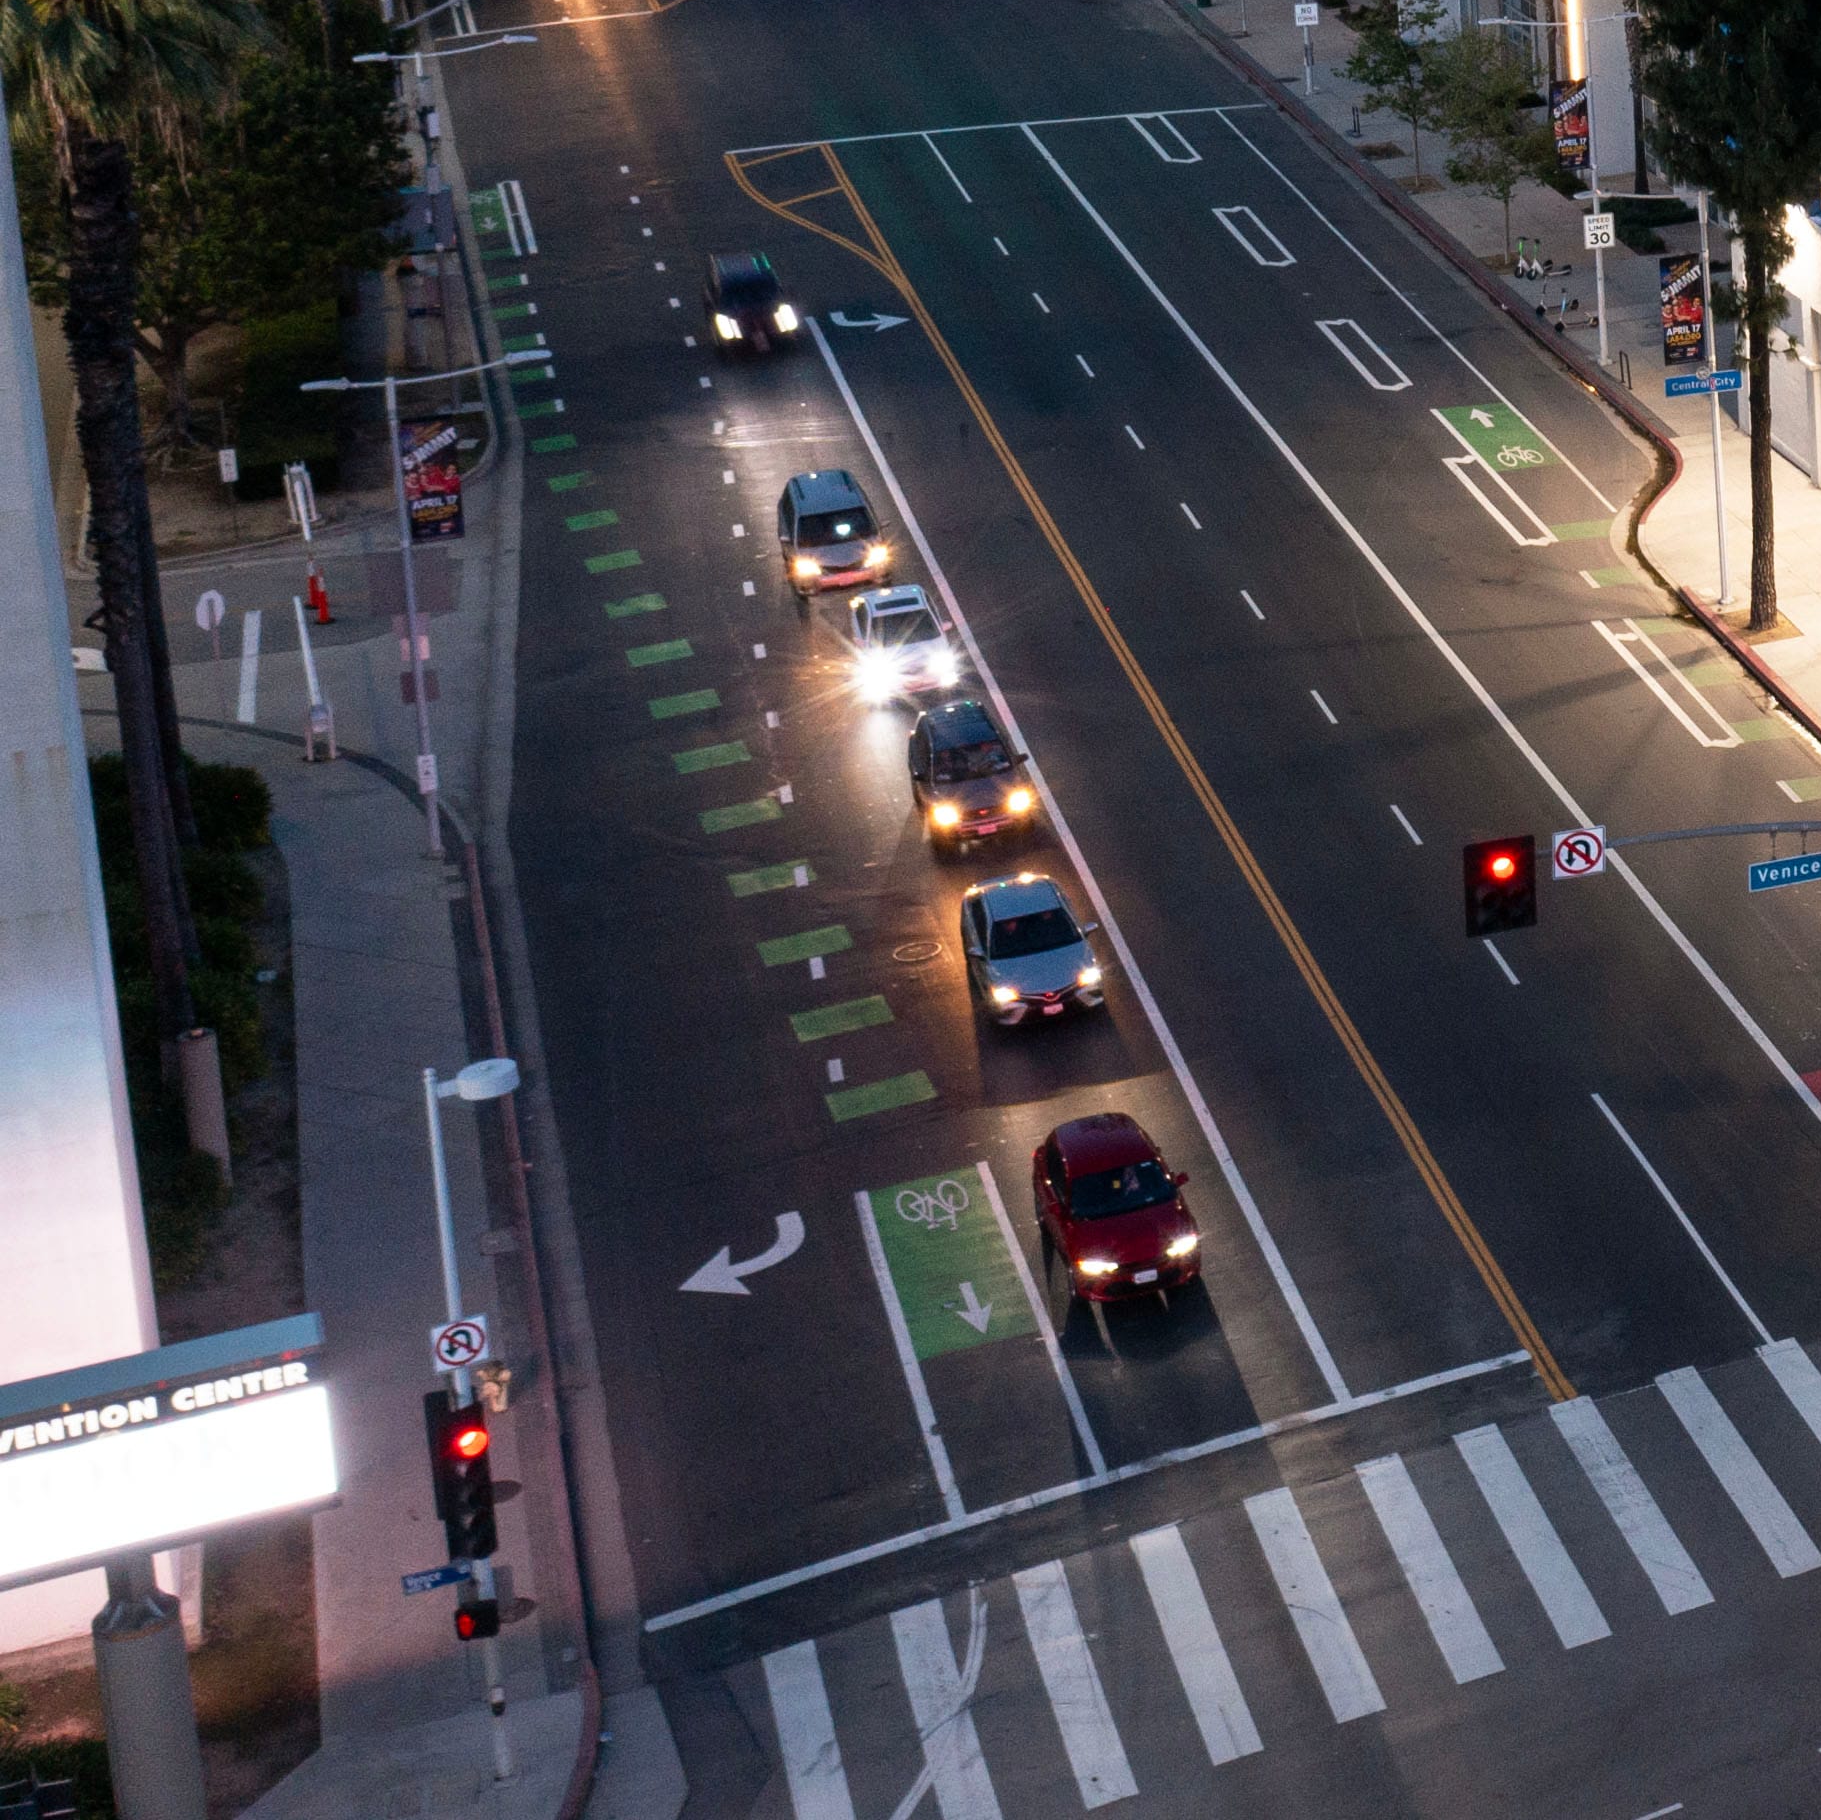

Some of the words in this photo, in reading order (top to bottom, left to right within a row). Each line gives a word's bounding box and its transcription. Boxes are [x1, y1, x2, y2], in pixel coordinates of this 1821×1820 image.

[1557, 138, 1578, 148] APRIL
[1588, 216, 1610, 225] SPEED
[1588, 224, 1609, 232] LIMIT
[1590, 231, 1610, 245] 30
[1660, 264, 1702, 303] SUMMIT
[1666, 327, 1690, 337] APRIL
[1691, 323, 1701, 332] 17
[1671, 379, 1710, 392] Central
[1714, 376, 1736, 387] City
[1757, 861, 1821, 883] Venice
[171, 1362, 309, 1412] CENTER
